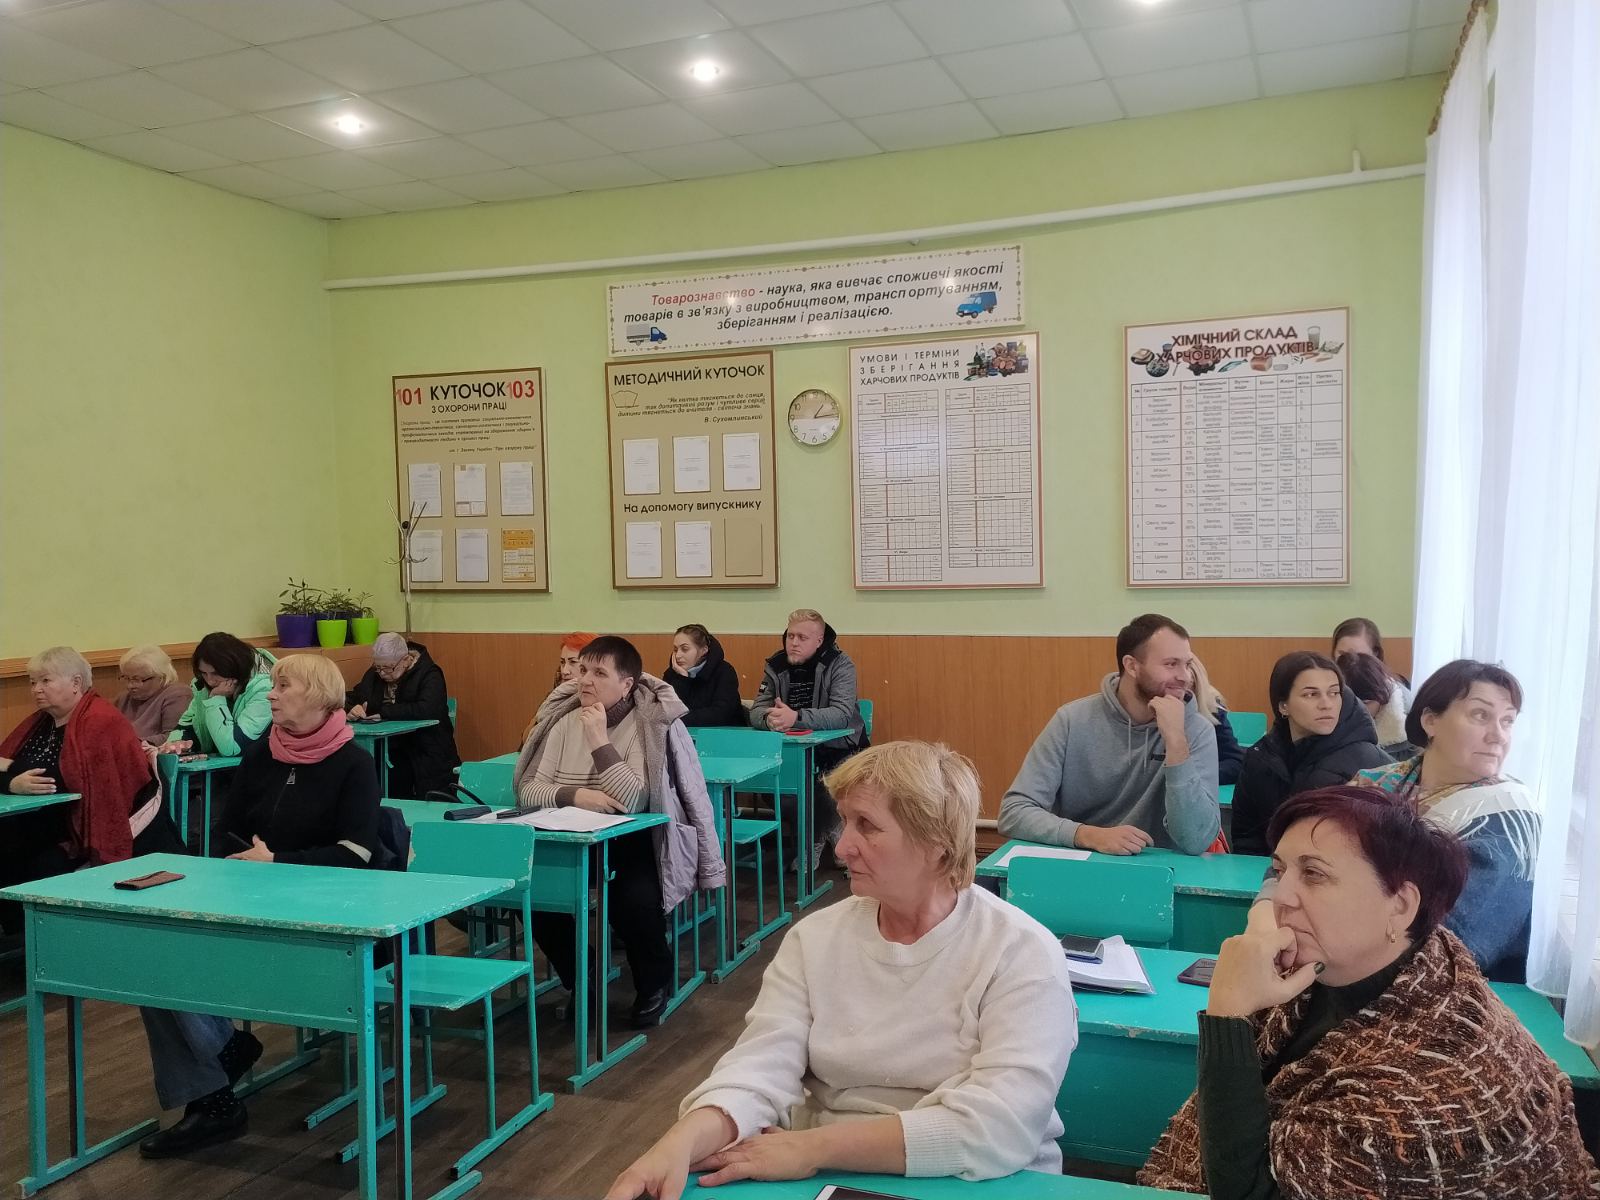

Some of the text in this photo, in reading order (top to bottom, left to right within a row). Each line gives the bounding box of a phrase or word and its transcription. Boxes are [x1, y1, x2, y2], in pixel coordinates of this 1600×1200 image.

[651, 288, 756, 306] Товарознавство
[766, 283, 806, 296] наука,
[810, 280, 832, 290] яка
[836, 276, 883, 289] вивчає
[887, 266, 951, 283] споживчі
[954, 261, 1004, 277] якості
[624, 308, 673, 323] товарів
[677, 309, 684, 319] в
[687, 304, 733, 318] зв'язку
[735, 305, 742, 314] з
[745, 294, 850, 313] виробництвом,
[716, 306, 893, 331] зберіганням і реалізацією.
[1171, 326, 1298, 347] ХІМІЧНИЙ СКЛАД
[860, 353, 898, 363] УМОВИ
[915, 349, 960, 360] ТЕРМІНИ
[1156, 341, 1315, 363] ХАРЧОВИХ ПРОДУКТІВ
[614, 364, 765, 386] МЕТОДИЧНИЙ КУТОЧОК
[860, 371, 960, 386] ХАРЧОВИХ ПРОДУКТІВ
[430, 381, 507, 401] КУТОЧОК
[438, 403, 481, 413] ОХОРОНИ
[482, 402, 507, 411] ПРАЦІ
[624, 500, 762, 514] На допомогу випускнику
